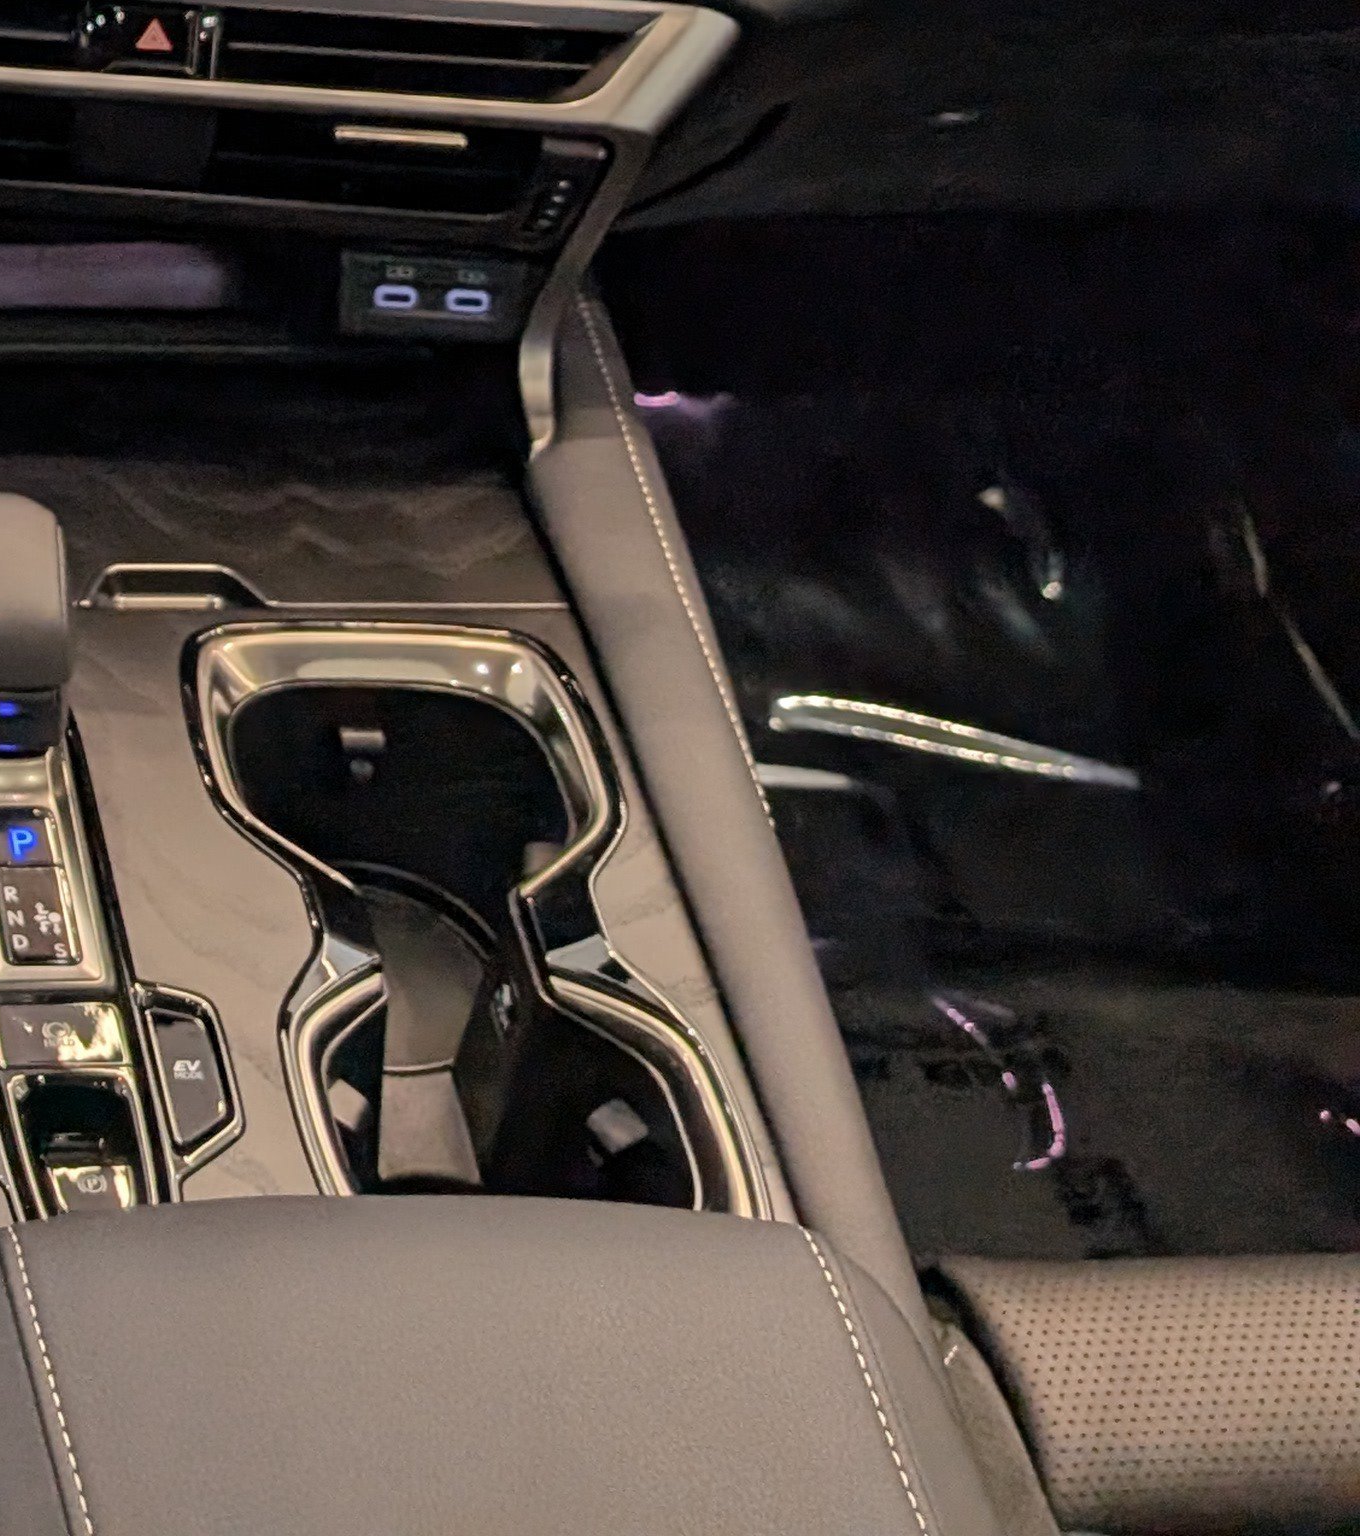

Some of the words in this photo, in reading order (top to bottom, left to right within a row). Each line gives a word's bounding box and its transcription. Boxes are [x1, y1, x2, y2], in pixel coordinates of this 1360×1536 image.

[9, 828, 35, 857] P
[3, 885, 19, 902] R
[7, 909, 25, 927] N
[12, 934, 30, 951] D
[54, 942, 68, 959] S
[175, 1060, 200, 1072] EV
[175, 1071, 204, 1081] MODE
